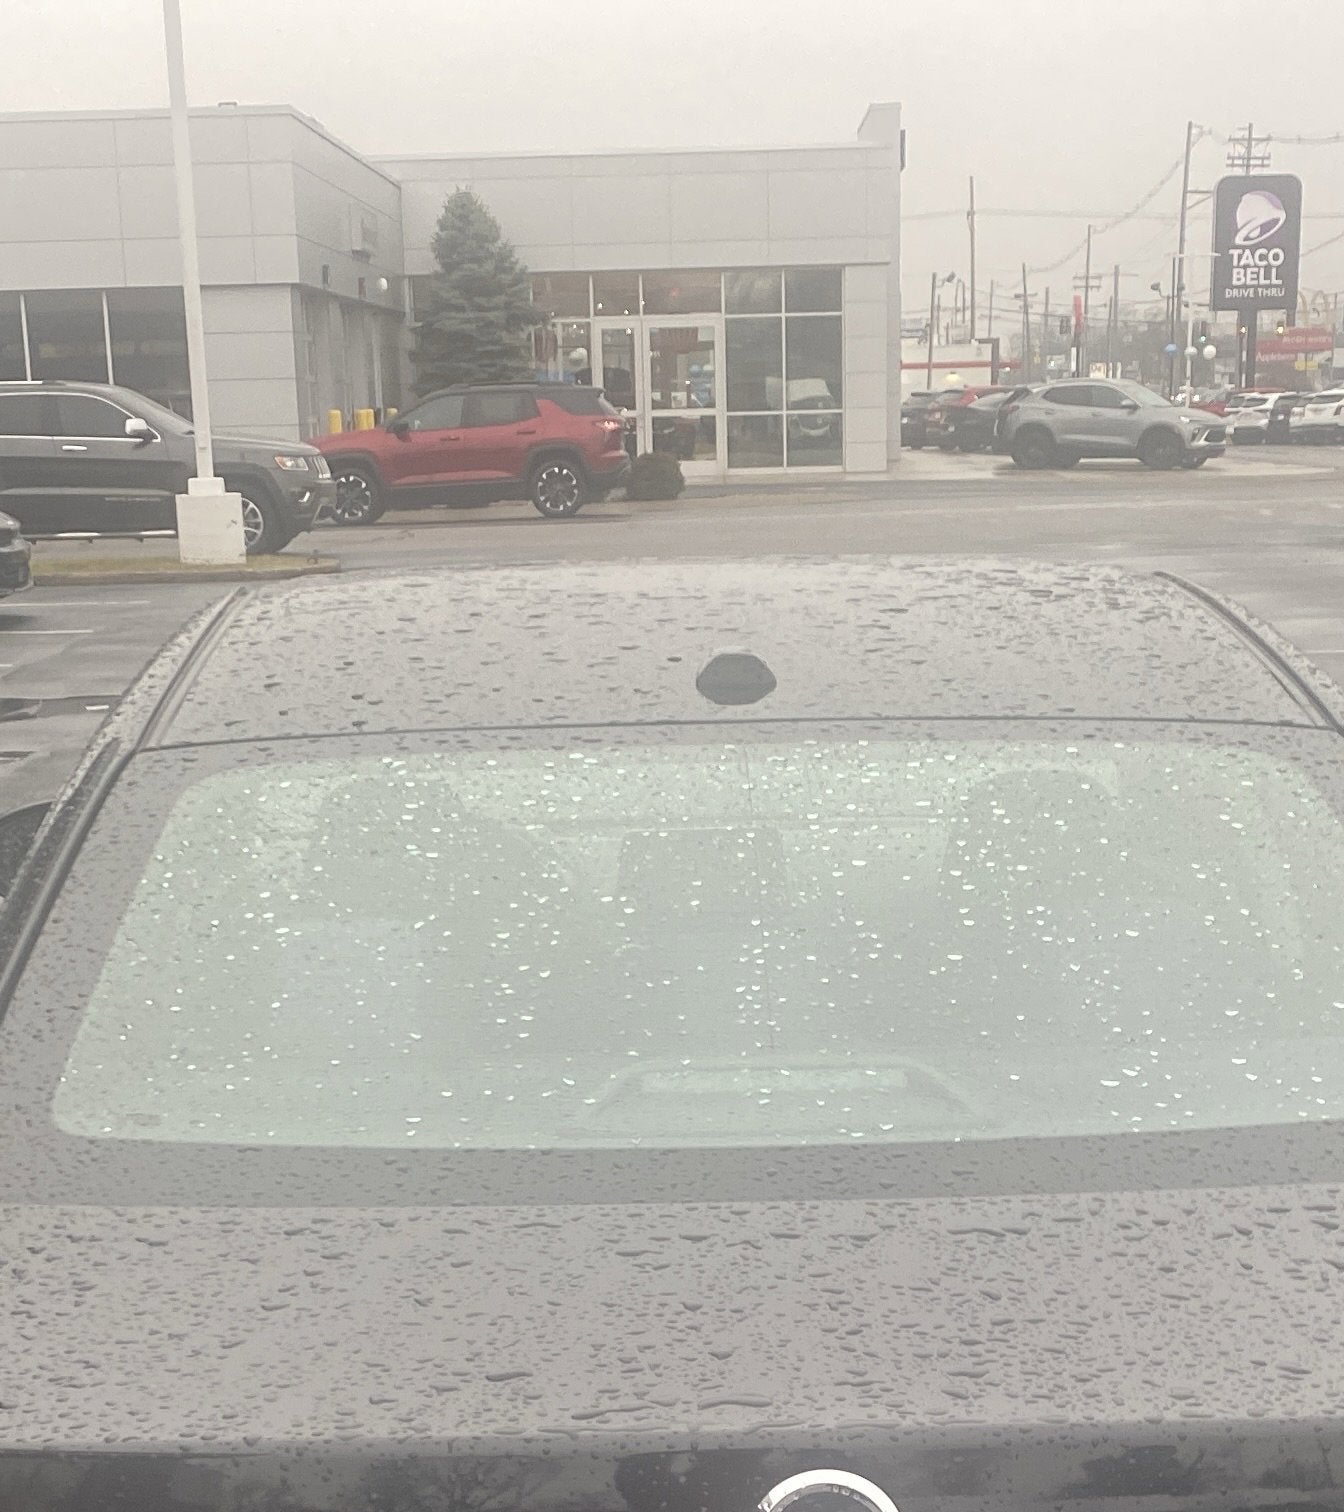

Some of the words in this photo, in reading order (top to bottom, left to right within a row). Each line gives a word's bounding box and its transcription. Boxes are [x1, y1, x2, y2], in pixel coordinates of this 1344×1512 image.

[1229, 248, 1285, 267] TACO
[1232, 267, 1283, 286] BELL
[1225, 287, 1255, 299] DRIVE
[1257, 286, 1286, 298] THRU
